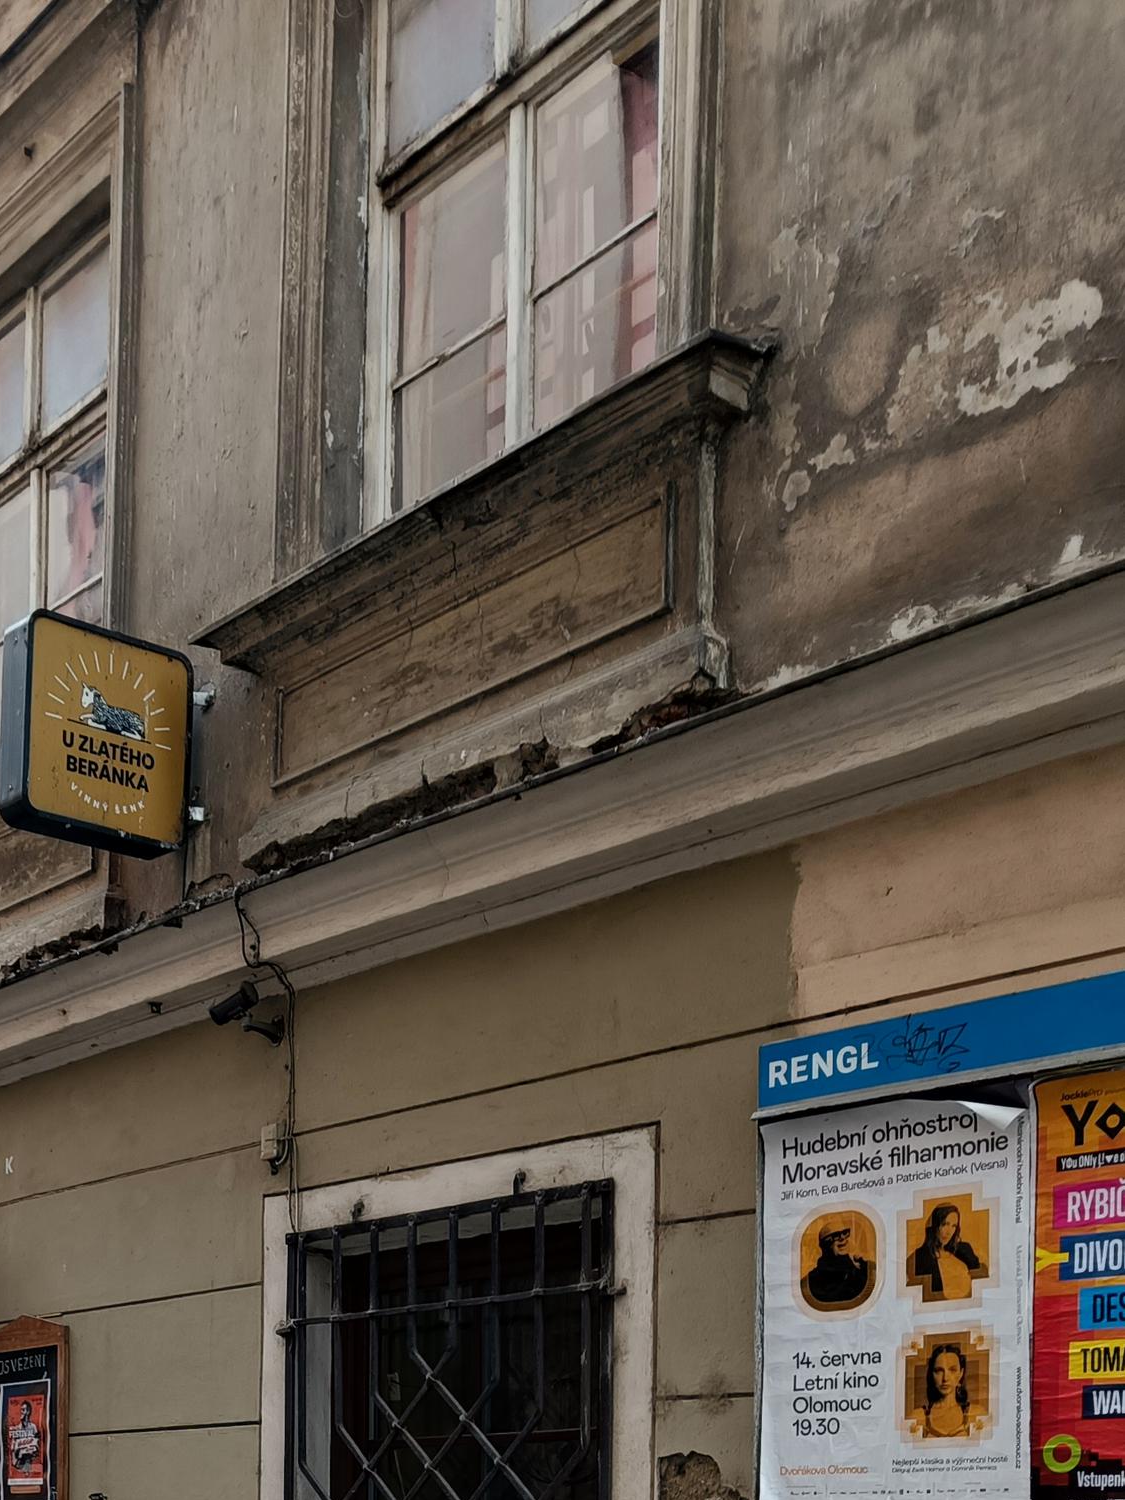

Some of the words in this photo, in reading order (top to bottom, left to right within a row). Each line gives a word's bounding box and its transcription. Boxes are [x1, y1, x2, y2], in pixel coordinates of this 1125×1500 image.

[62, 730, 74, 748] U
[78, 735, 155, 771] ZLATÉHO
[66, 755, 149, 793] BERÁNKA
[71, 782, 109, 812] VINNÝ
[768, 1042, 880, 1089] RENGL
[782, 1125, 867, 1159] Hudební
[782, 1150, 883, 1185] Moravské
[888, 1131, 1009, 1168] filharmonie
[781, 1190, 795, 1201] Jiří
[822, 1184, 839, 1195] Eva
[841, 1176, 886, 1193] Burešová
[887, 1178, 893, 1186] a
[896, 1169, 932, 1184] Patricie
[934, 1164, 968, 1179] Kaňok
[970, 1158, 1009, 1176] (Vesna)
[1074, 1239, 1125, 1274] DIVO
[792, 1352, 815, 1369] 14.
[821, 1350, 881, 1368] června
[792, 1372, 838, 1392] Letní
[843, 1371, 879, 1388] kino
[792, 1396, 872, 1414] Olomouc
[792, 1418, 841, 1436] 19.30
[780, 1463, 826, 1476] Dvořákova
[827, 1463, 868, 1475] Olomouc
